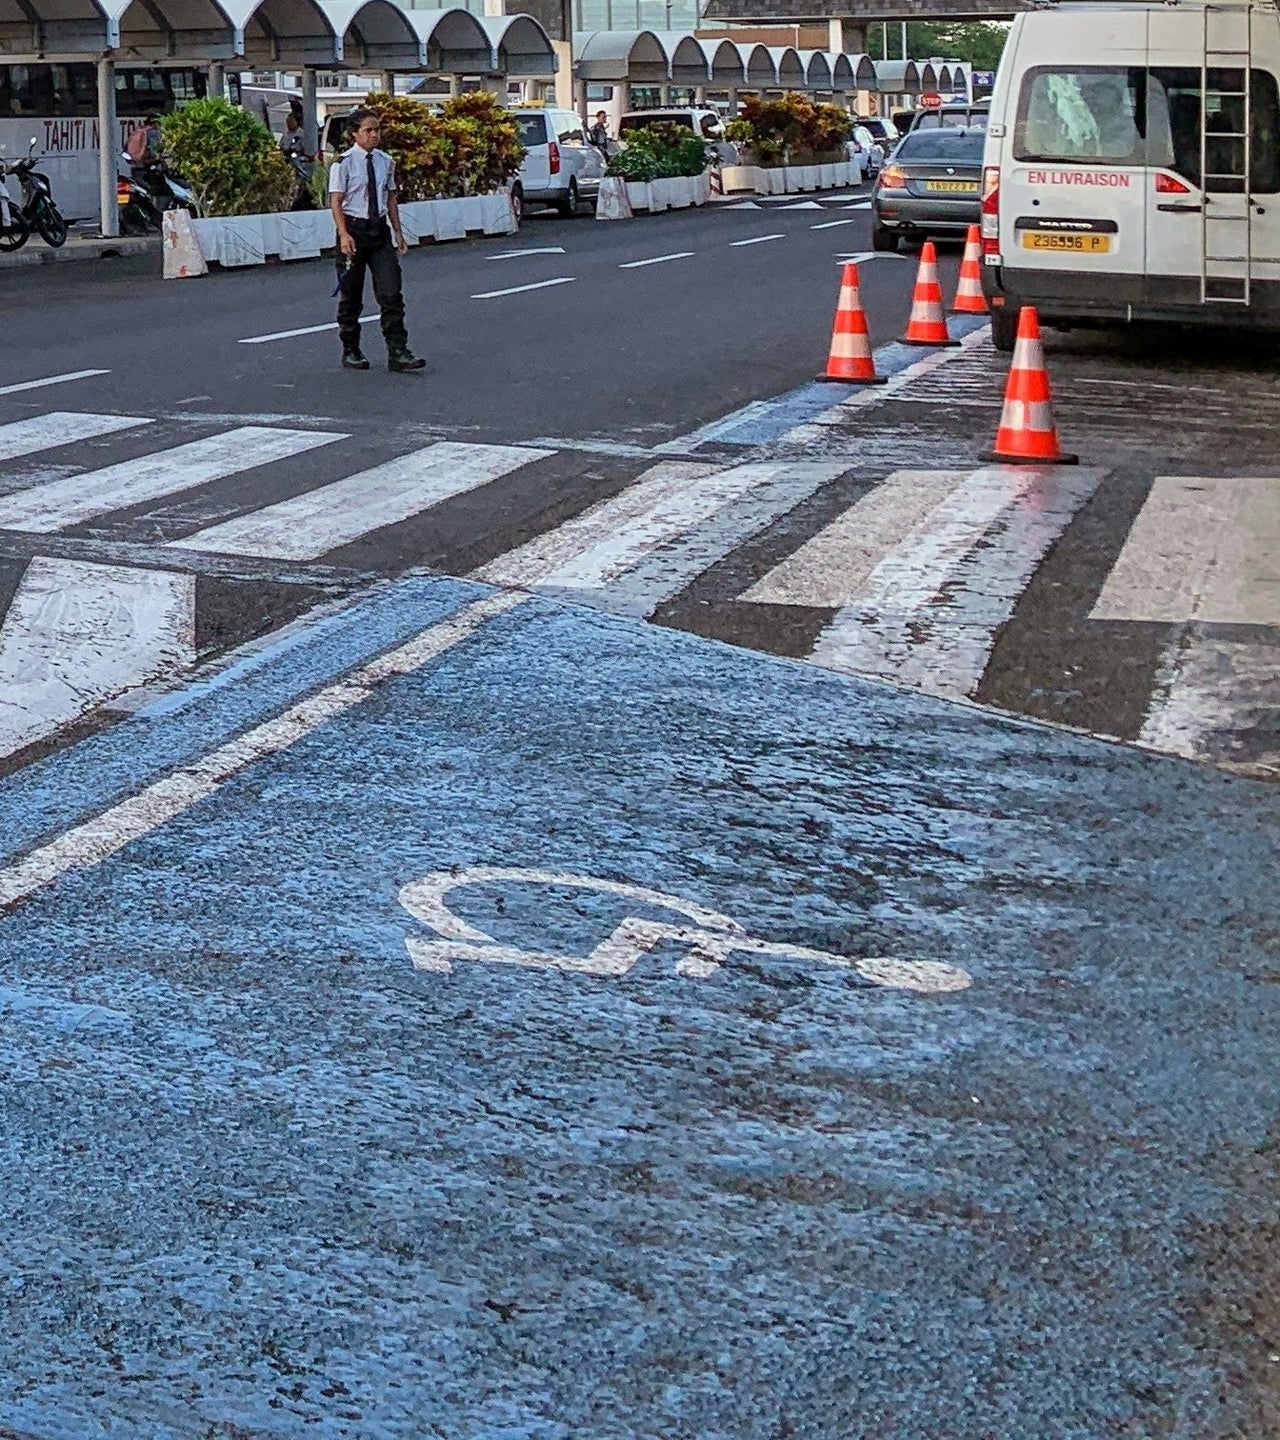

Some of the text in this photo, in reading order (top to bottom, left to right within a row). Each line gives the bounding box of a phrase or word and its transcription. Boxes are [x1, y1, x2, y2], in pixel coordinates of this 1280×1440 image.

[44, 119, 86, 151] TAHITI
[1028, 171, 1130, 187] EN LIVRAISON
[1091, 237, 1100, 250] P
